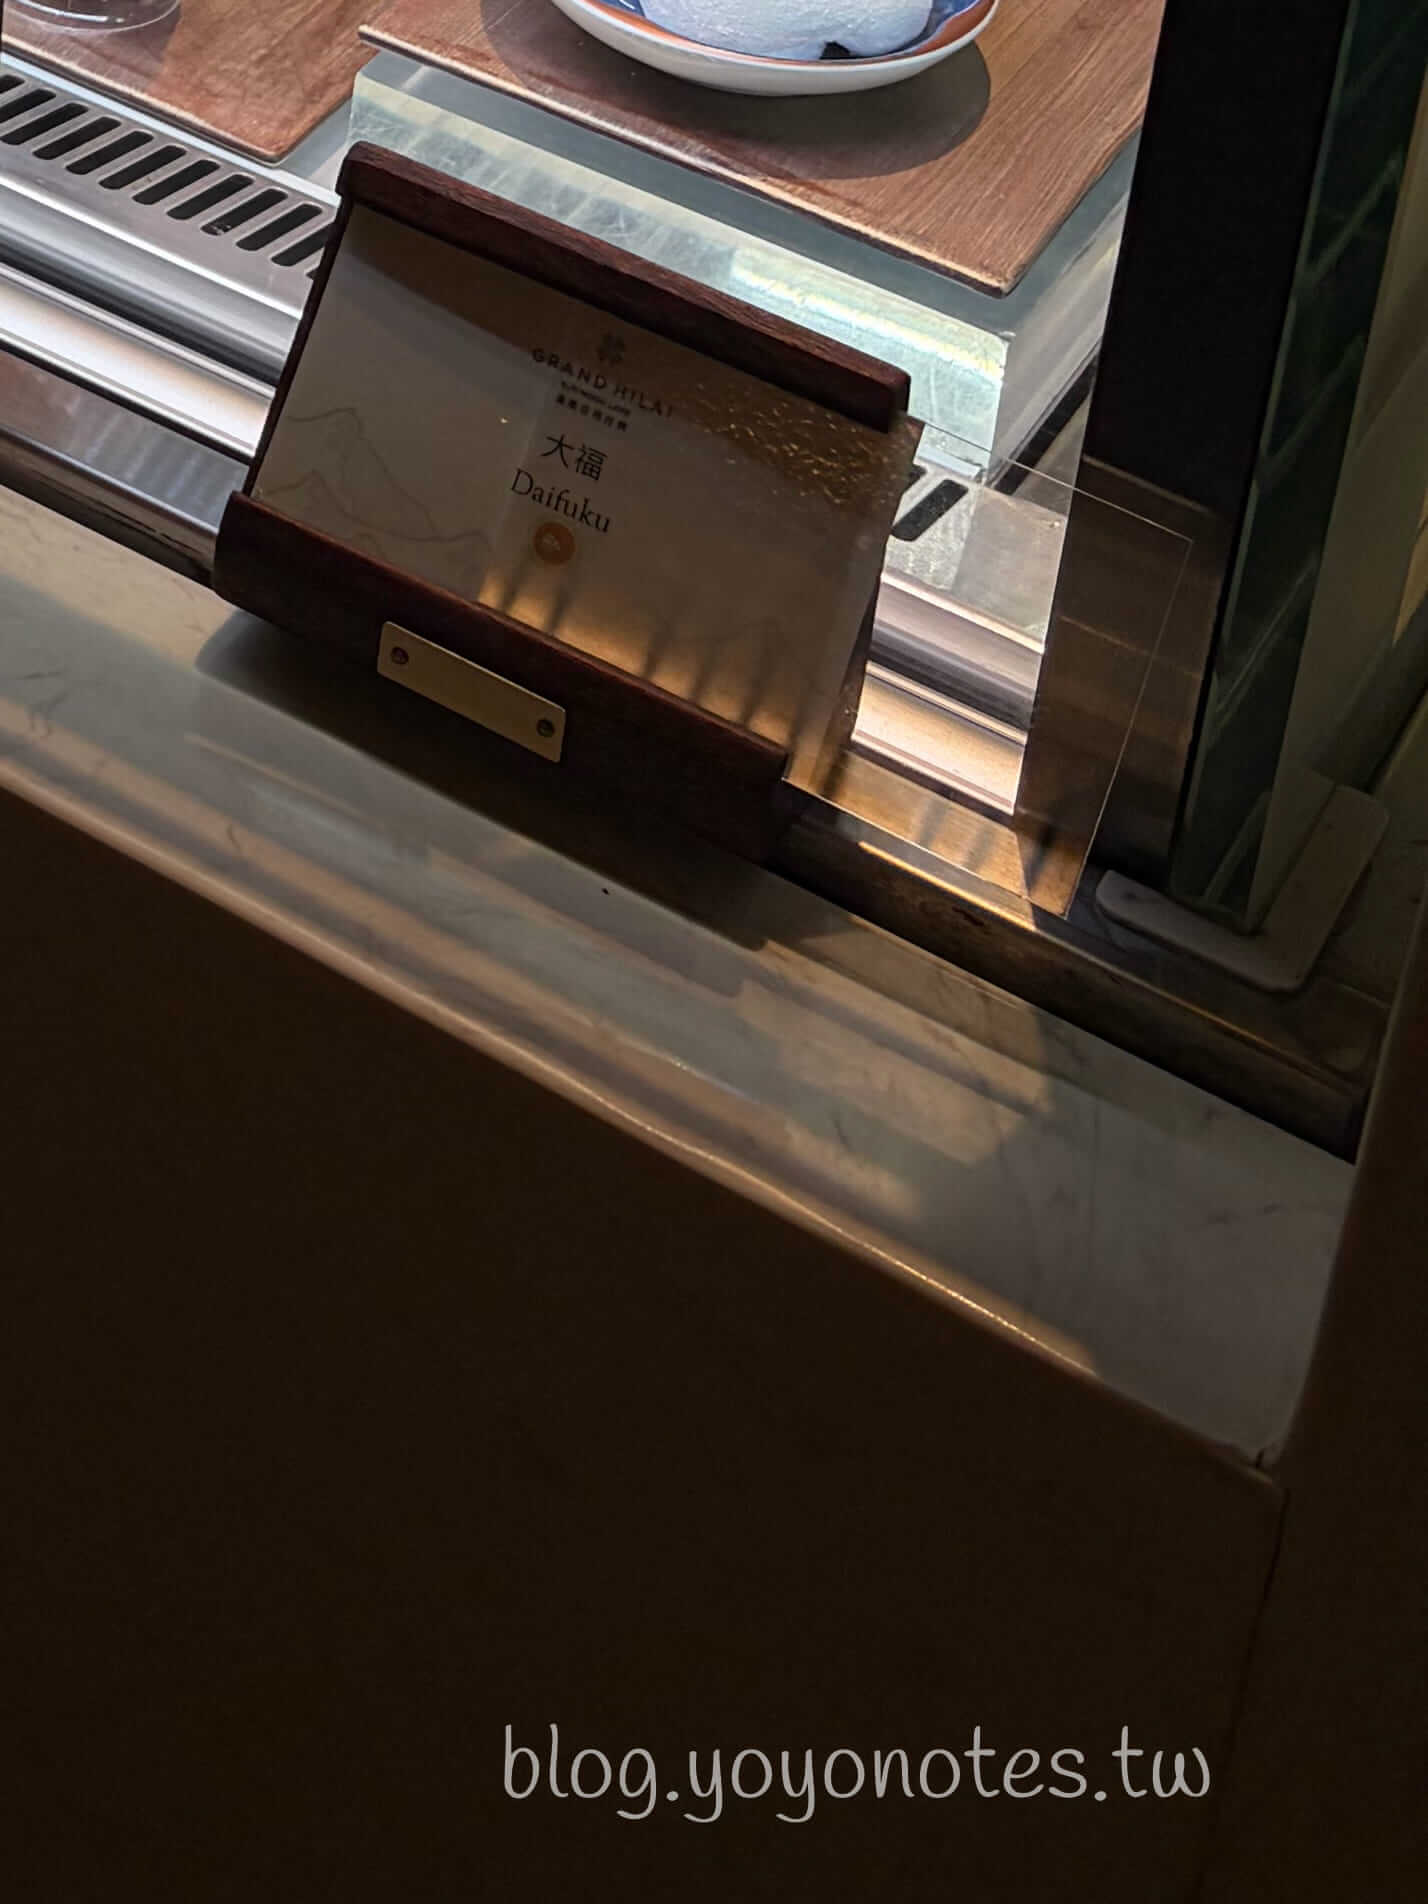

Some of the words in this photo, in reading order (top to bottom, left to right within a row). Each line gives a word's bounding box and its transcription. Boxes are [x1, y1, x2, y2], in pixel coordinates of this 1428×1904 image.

[531, 346, 609, 389] GRAND
[614, 383, 674, 418] HILAI
[540, 434, 609, 482] 大福
[510, 467, 612, 534] Daifuku
